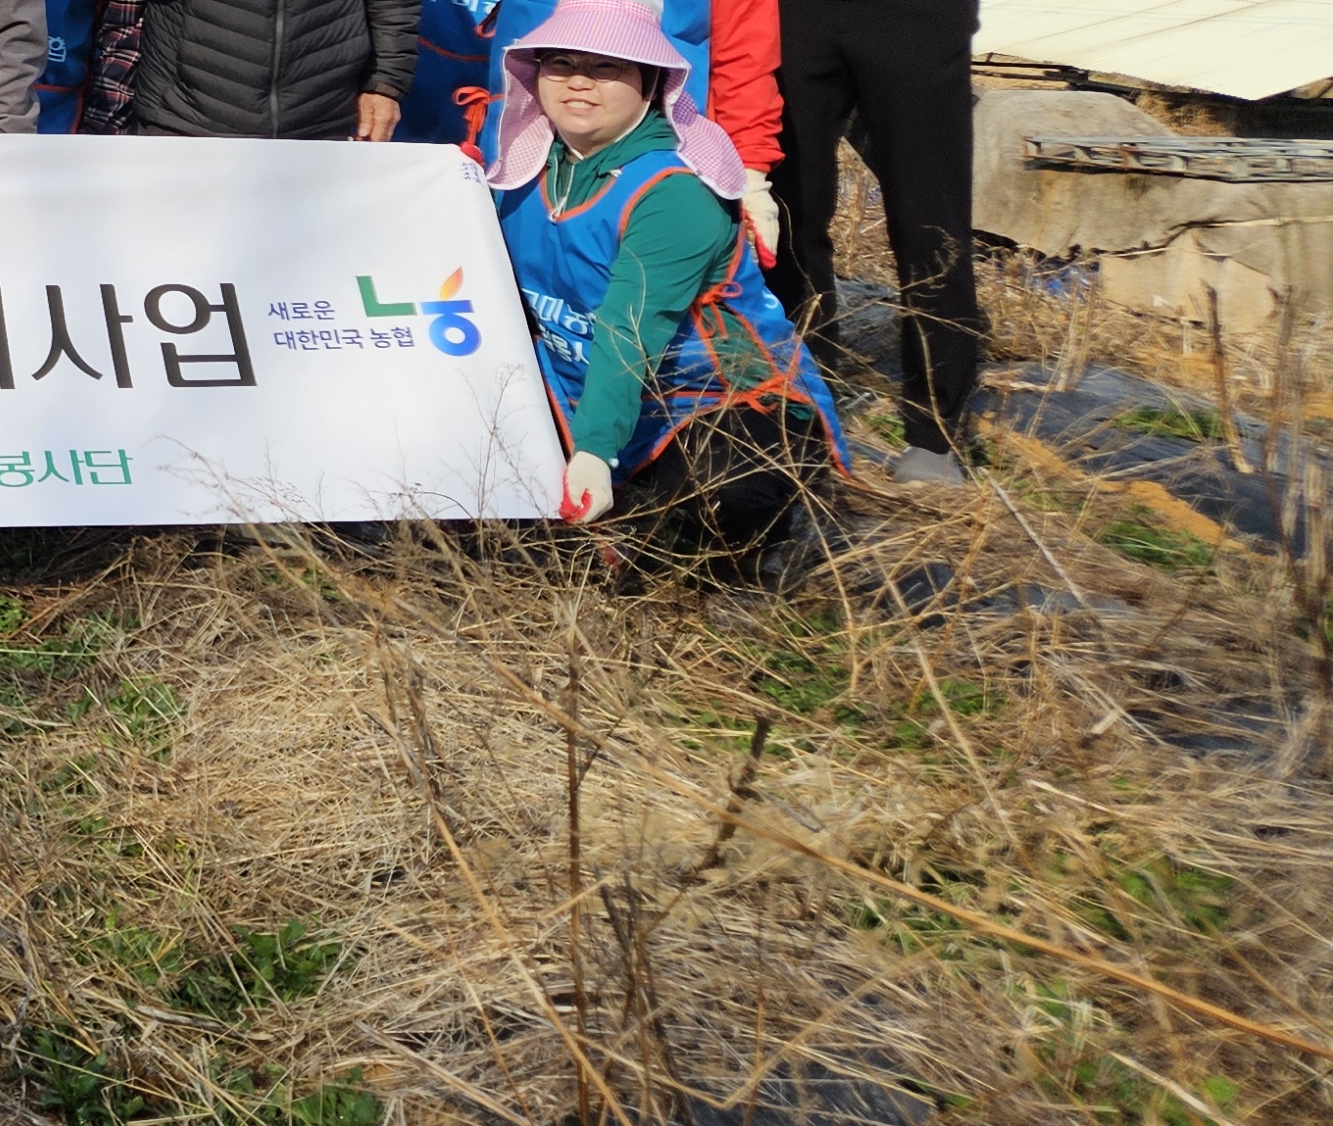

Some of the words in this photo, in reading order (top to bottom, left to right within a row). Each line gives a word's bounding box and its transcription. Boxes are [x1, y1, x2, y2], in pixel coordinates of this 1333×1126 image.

[268, 300, 335, 321] 새로운
[273, 328, 364, 350] 대한민국
[369, 327, 415, 349] 농협
